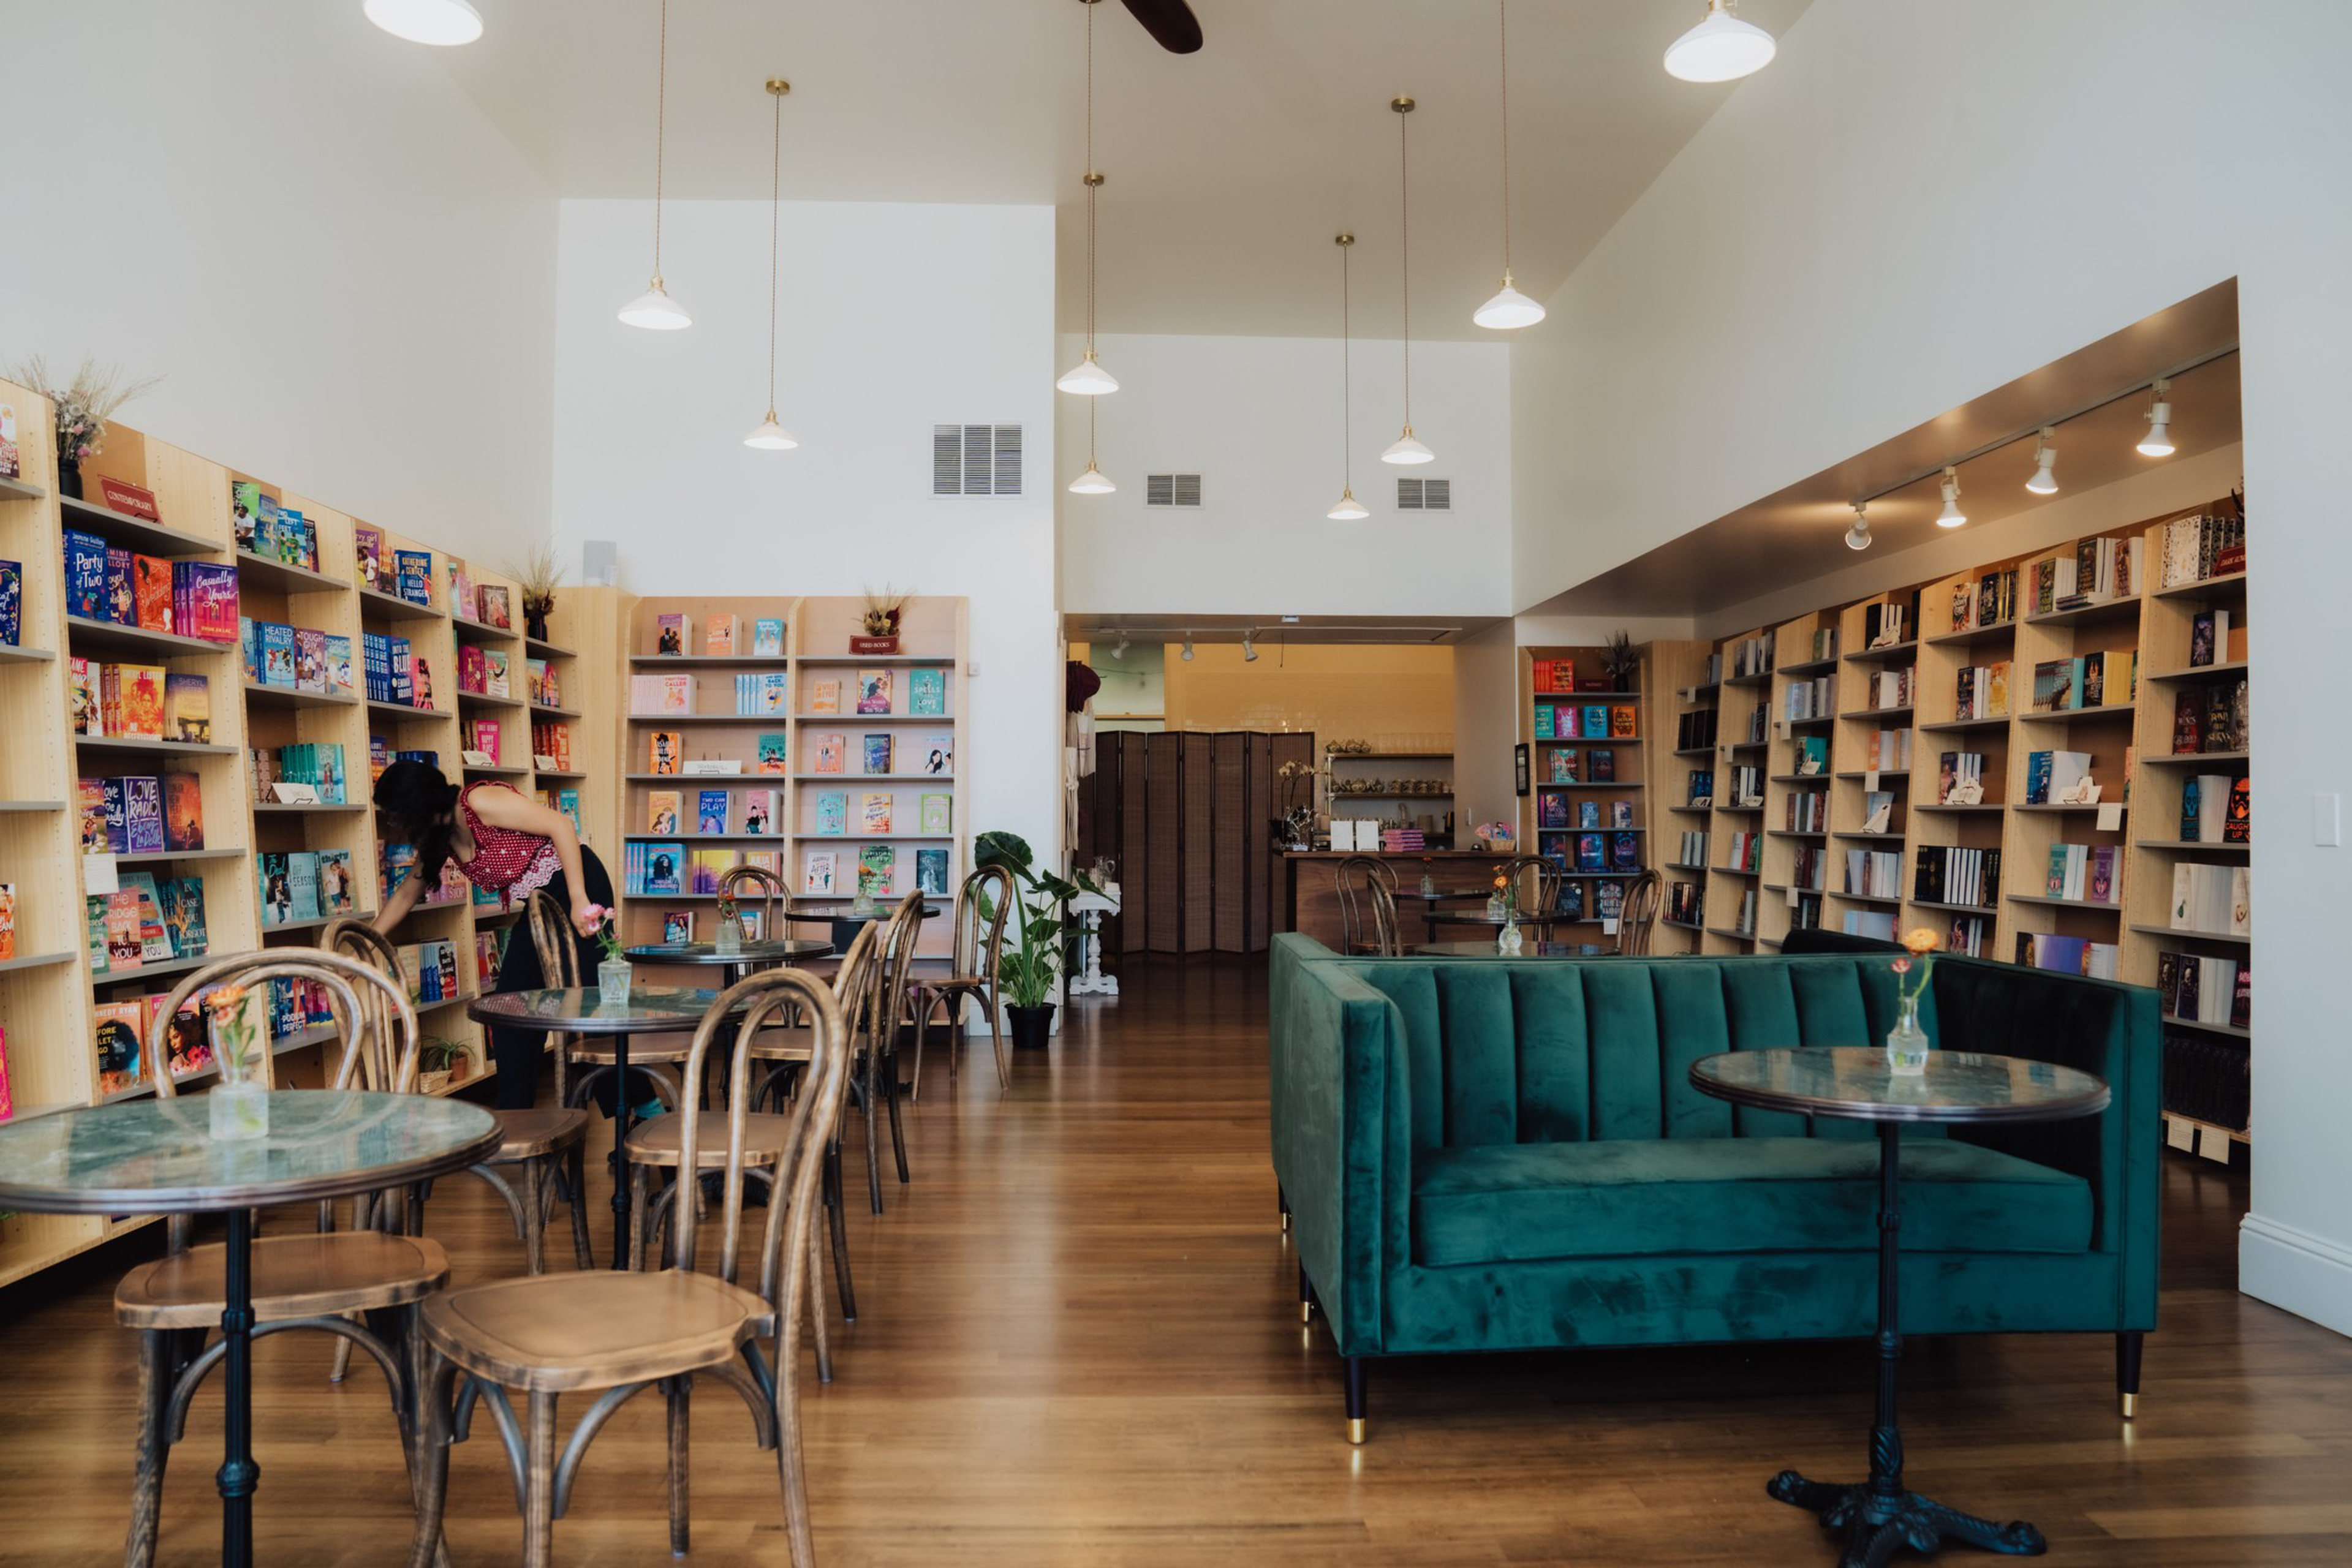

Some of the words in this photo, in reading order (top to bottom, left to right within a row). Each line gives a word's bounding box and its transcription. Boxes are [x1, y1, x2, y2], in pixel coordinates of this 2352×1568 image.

[107, 491, 153, 511] CONTEMPORARY
[76, 552, 103, 573] Party
[402, 557, 428, 567] KATHERINE
[75, 576, 83, 589] of
[82, 571, 102, 588] Two
[196, 570, 235, 589] Casually
[407, 578, 423, 588] HELLO
[202, 586, 238, 608] Yours
[265, 625, 293, 637] HEATED
[265, 633, 292, 646] RIVALRY
[299, 631, 324, 643] TOUGH
[324, 638, 349, 646] COMMON
[303, 640, 317, 650] GUY
[393, 654, 410, 673] BLUE
[179, 677, 205, 687] SHERYL
[318, 748, 335, 758] LONG
[128, 780, 156, 801] LOVE
[129, 799, 158, 820] RADIO
[701, 802, 725, 811] PLAY
[811, 864, 831, 872] AFTER
[293, 875, 315, 888] SEASON
[184, 883, 192, 892] IN
[448, 886, 465, 899] STOP
[110, 894, 129, 905] THE
[181, 898, 199, 908] CASE
[110, 921, 133, 932] BACK
[113, 948, 133, 959] YOU
[144, 946, 161, 957] YOU
[118, 1005, 138, 1015] RYAN
[282, 1019, 305, 1033] PERFECT
[98, 1036, 112, 1045] LET
